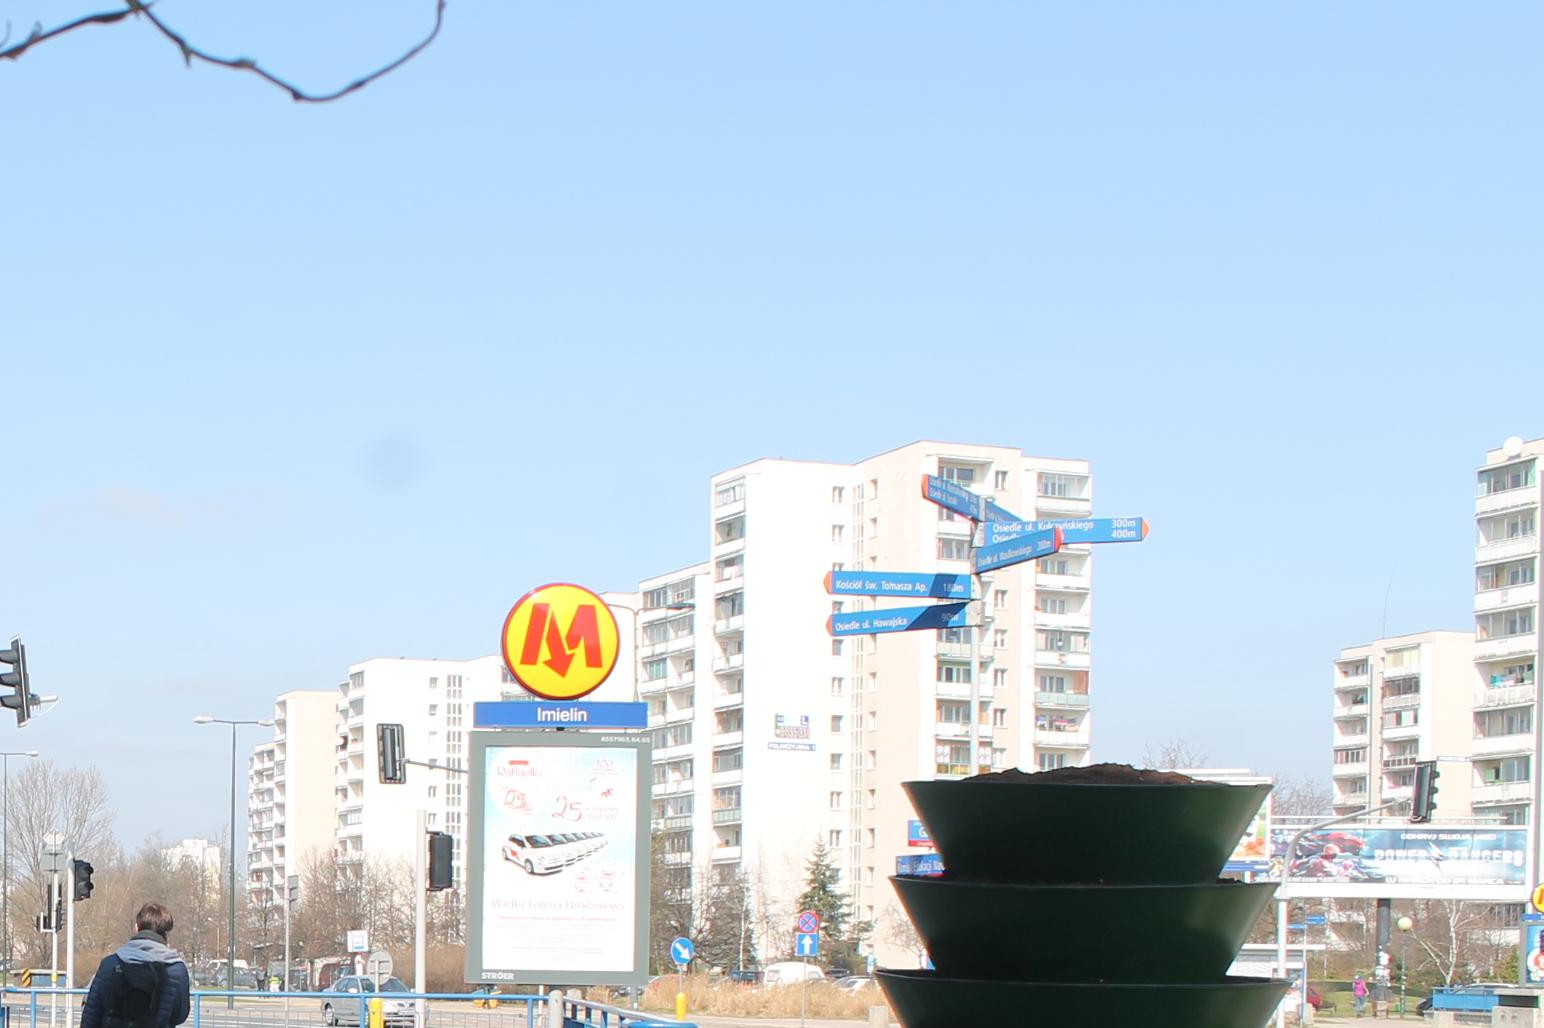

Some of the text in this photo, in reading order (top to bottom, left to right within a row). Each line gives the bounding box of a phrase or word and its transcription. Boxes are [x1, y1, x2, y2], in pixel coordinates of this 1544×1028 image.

[1111, 518, 1136, 528] 300m
[1111, 529, 1136, 539] 400m
[836, 580, 862, 590] Kościół
[881, 580, 912, 591] Tomasza
[915, 582, 927, 593] Ap.
[835, 621, 860, 631] Osiedle
[873, 616, 908, 629] Hawajska
[537, 707, 588, 722] Imielin
